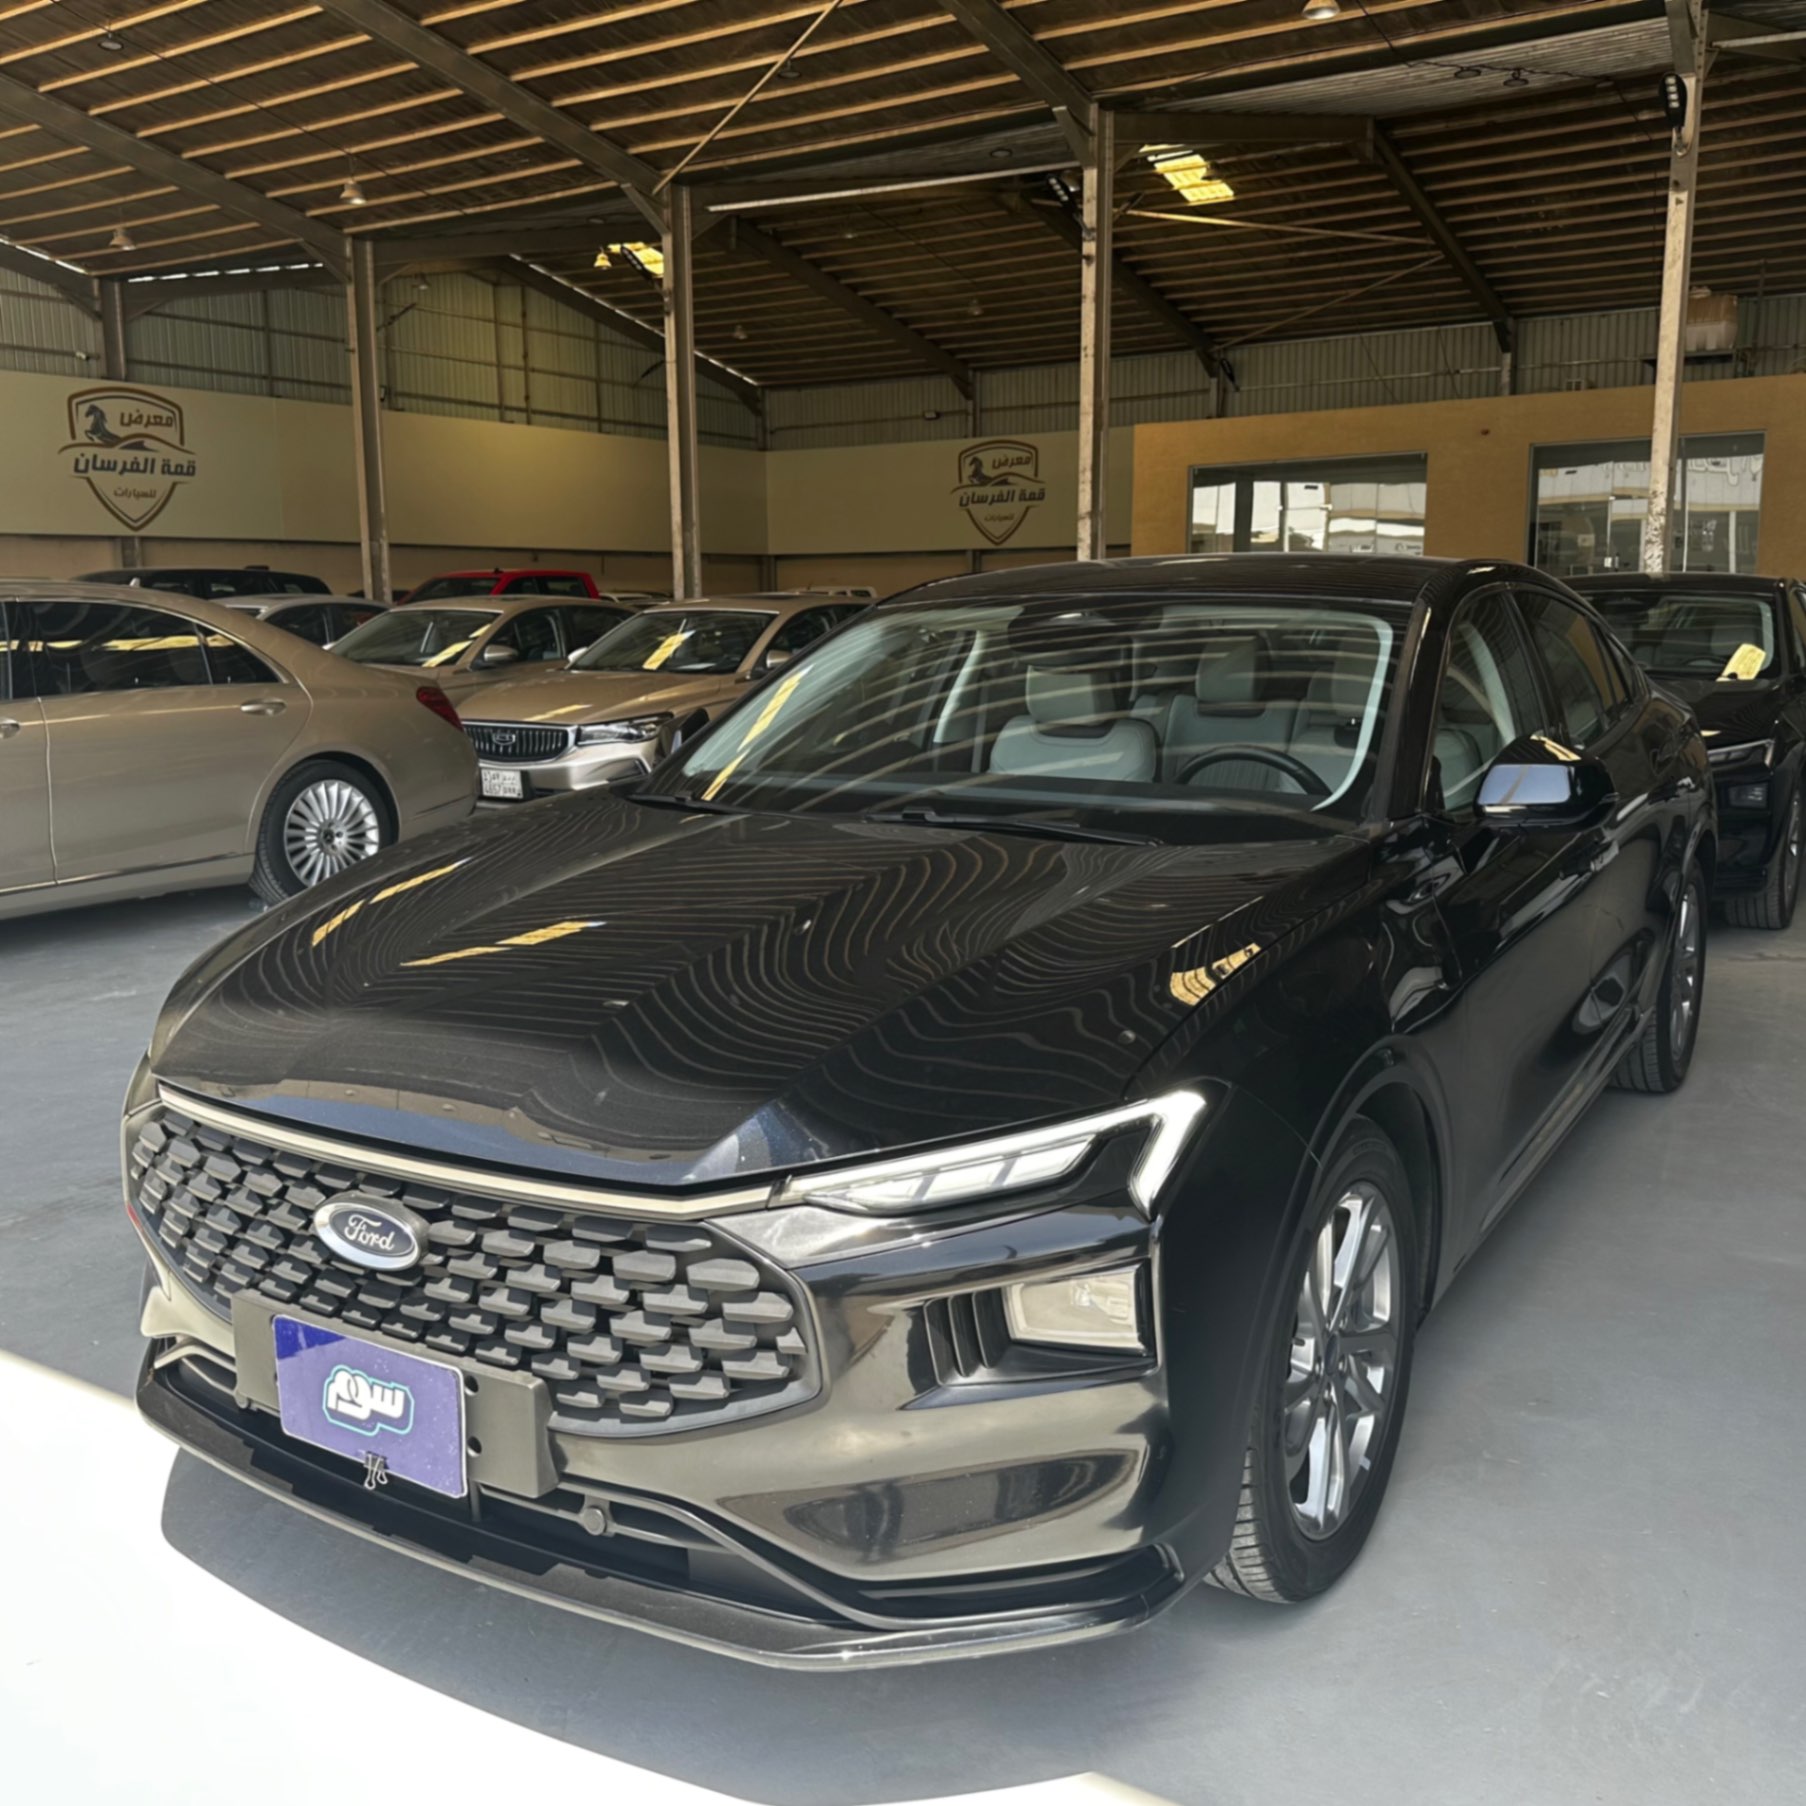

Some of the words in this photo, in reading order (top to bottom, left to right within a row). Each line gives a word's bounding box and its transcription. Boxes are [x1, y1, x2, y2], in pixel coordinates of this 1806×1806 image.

[120, 409, 174, 428] معرض
[73, 453, 155, 476] الفرسان
[161, 459, 196, 477] قمة
[992, 454, 1031, 469] معرض
[959, 490, 1015, 507] الفرسان
[1018, 488, 1046, 502] قمة
[344, 1213, 395, 1251] Ford
